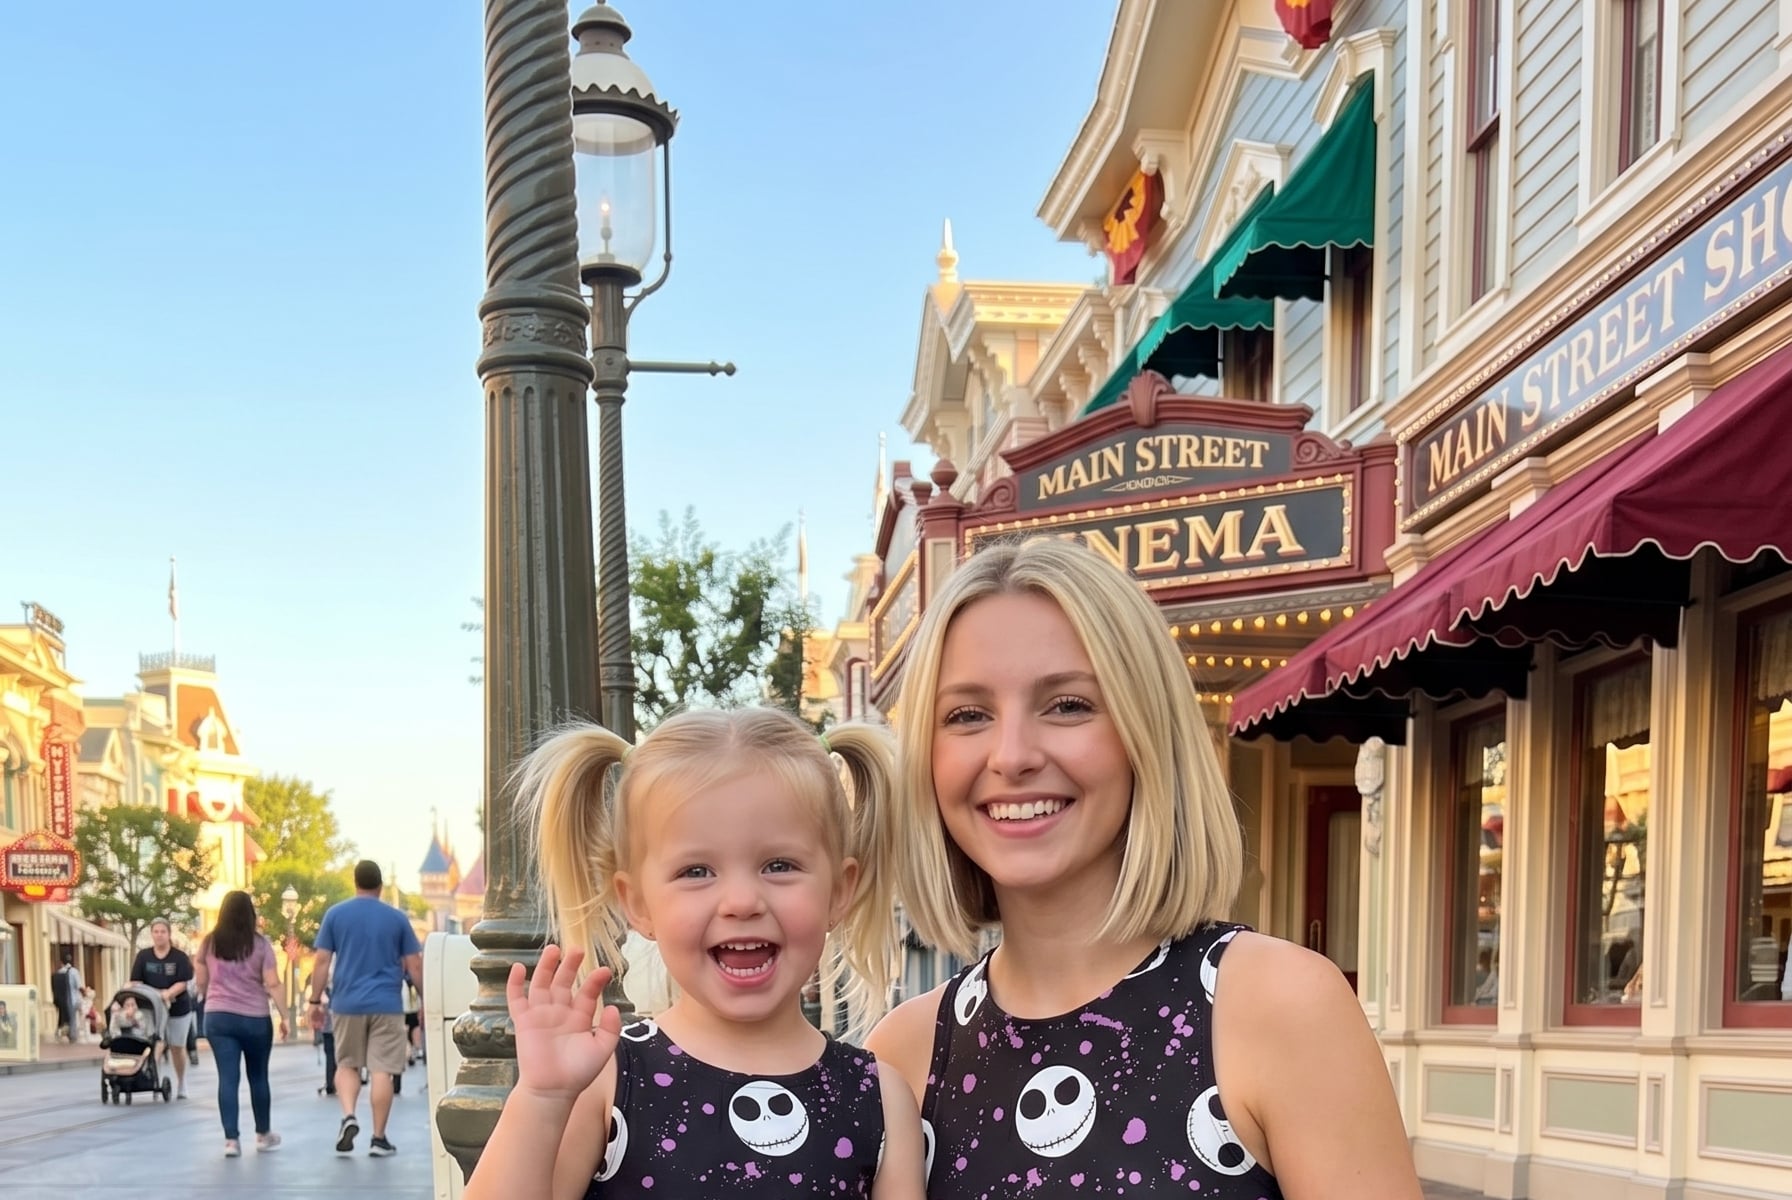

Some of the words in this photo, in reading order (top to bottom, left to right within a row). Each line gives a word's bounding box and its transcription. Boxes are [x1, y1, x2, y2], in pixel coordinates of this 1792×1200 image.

[1428, 387, 1509, 493] MAIN
[1520, 256, 1684, 428] STREET
[1703, 176, 1792, 301] SH
[1038, 442, 1126, 500] MAIN
[1135, 434, 1270, 473] STREET
[1020, 504, 1307, 575] NEMA
